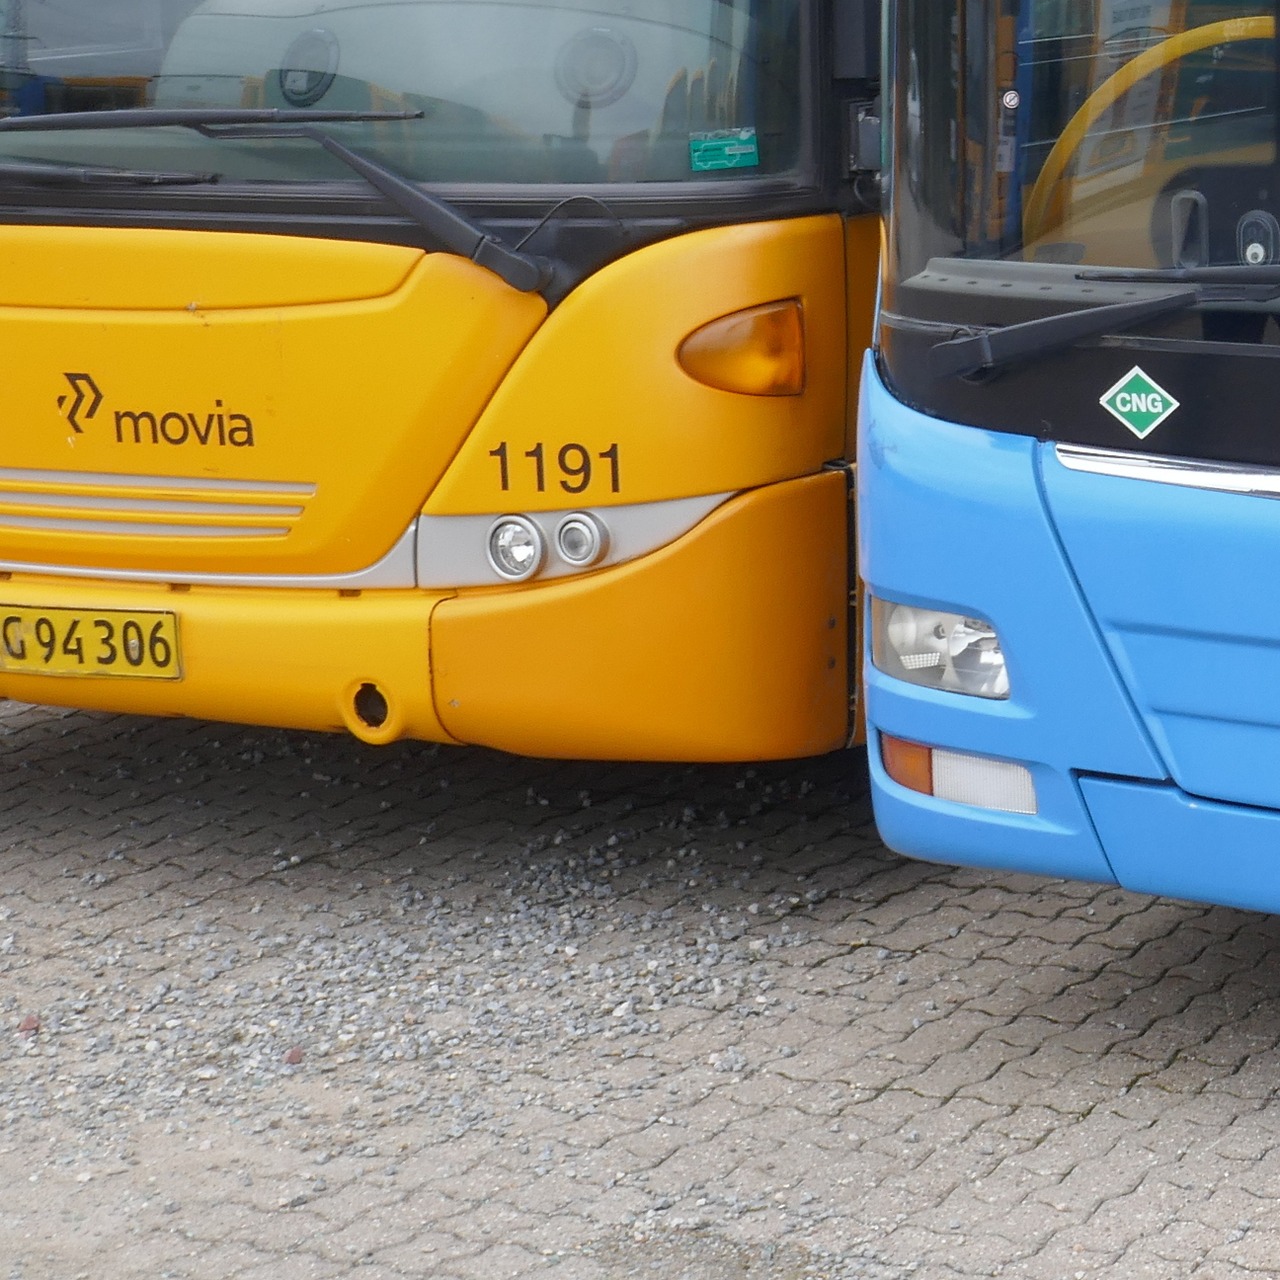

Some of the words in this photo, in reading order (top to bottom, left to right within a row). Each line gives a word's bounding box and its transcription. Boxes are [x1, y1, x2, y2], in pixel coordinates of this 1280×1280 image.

[114, 399, 256, 448] movia
[1115, 391, 1164, 415] CNG
[488, 440, 623, 494] 1191
[35, 617, 85, 664] 94
[93, 619, 171, 668] 306
